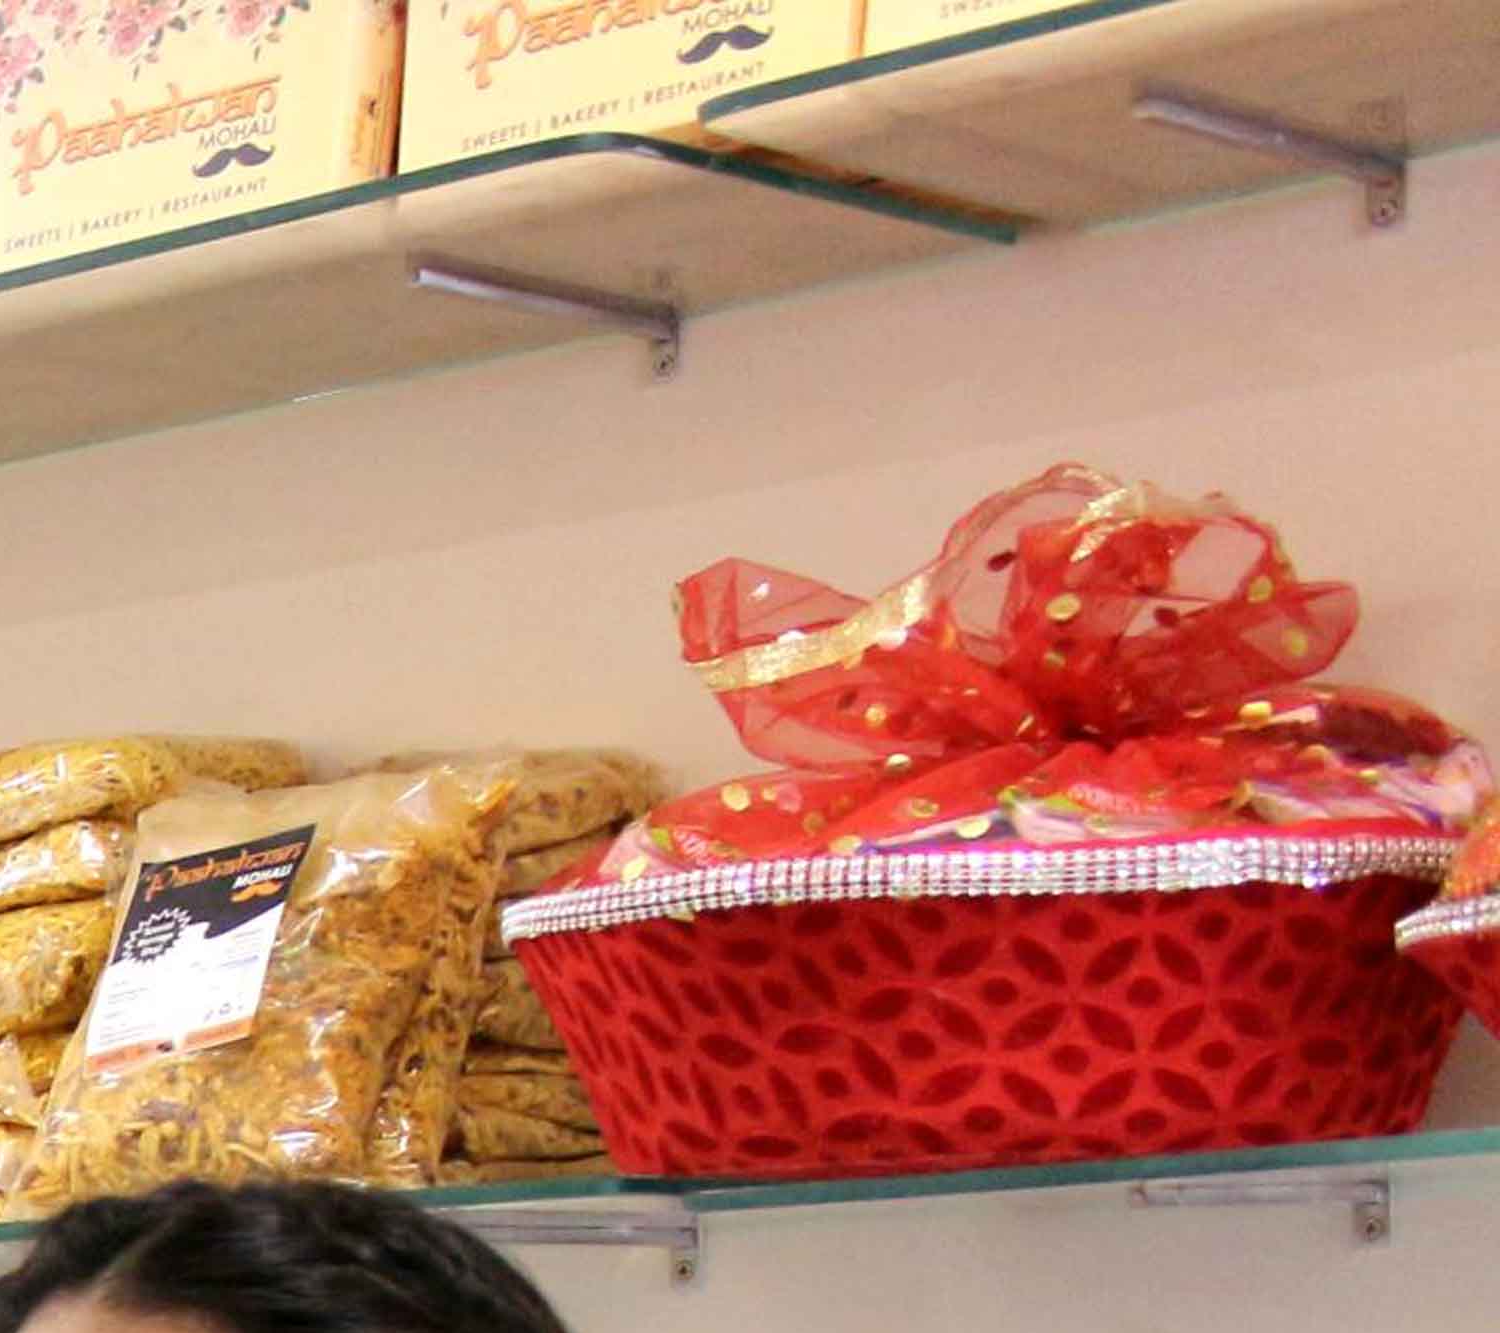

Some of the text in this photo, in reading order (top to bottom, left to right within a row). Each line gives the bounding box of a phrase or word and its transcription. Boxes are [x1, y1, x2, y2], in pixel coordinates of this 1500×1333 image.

[198, 115, 276, 149] MOHALI
[461, 62, 766, 152] SWEETS BAKERY RESTAURANT
[4, 176, 270, 253] SWEETS BAKERY RESTAURANT
